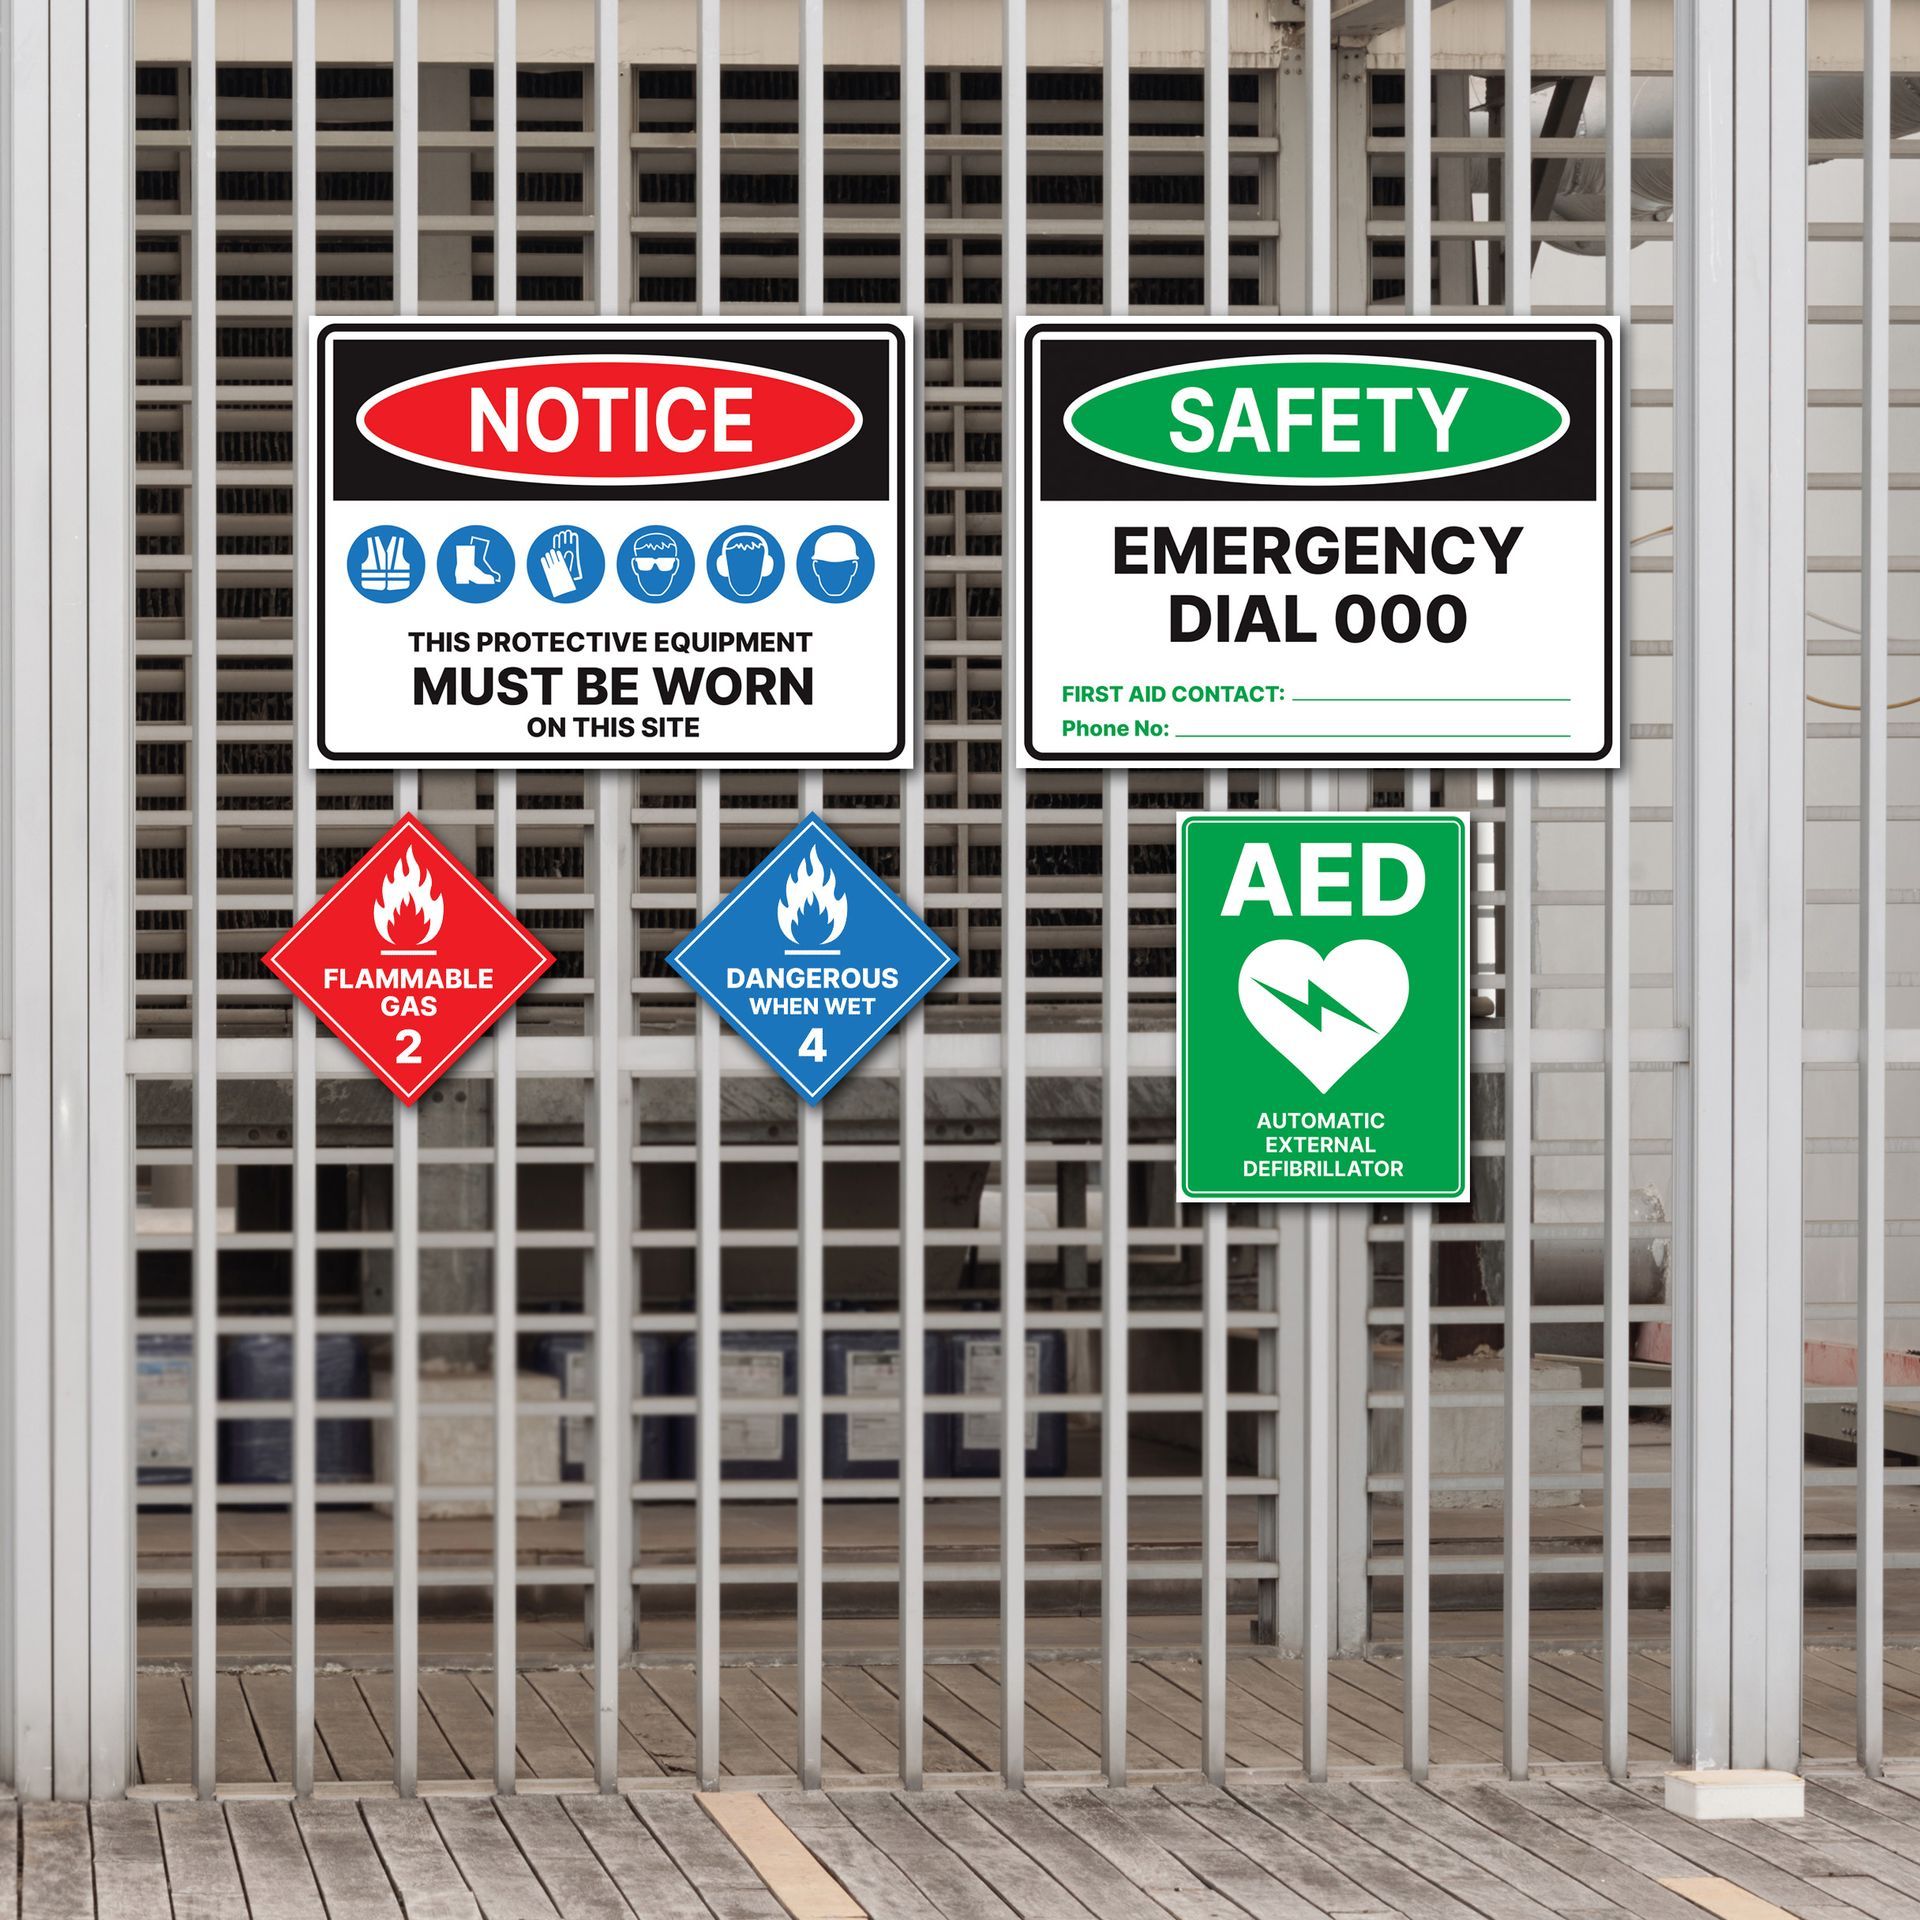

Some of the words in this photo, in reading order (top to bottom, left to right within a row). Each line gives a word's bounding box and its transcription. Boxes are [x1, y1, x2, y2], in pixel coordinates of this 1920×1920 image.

[471, 387, 752, 453] NOTICE
[1170, 387, 1468, 453] SAFETY
[1115, 526, 1524, 574] EMERGENCY
[1171, 595, 1317, 642] DIAL
[1335, 594, 1466, 643] 000
[408, 632, 470, 652] THIS
[478, 632, 647, 652] PROTECTIVE
[655, 632, 813, 653] EQUIPMENT
[414, 667, 563, 705] MUST
[578, 667, 638, 705] BE
[653, 667, 812, 705] WORN
[1063, 686, 1123, 702] FIRST
[1129, 686, 1166, 702] AID
[1172, 686, 1284, 702] CONTACT:
[527, 717, 565, 737] ON
[573, 717, 634, 737] THIS
[642, 717, 699, 737] SITE
[1063, 720, 1129, 736] Phone
[1135, 720, 1168, 736] No:
[1221, 843, 1425, 916] AED
[325, 968, 493, 988] FLAMMABLE
[727, 968, 898, 988] DANGEROUS
[381, 996, 437, 1016] GAS
[749, 998, 818, 1014] WHEN
[824, 998, 876, 1014] WET
[396, 1029, 422, 1063] 2
[799, 1028, 827, 1062] 4
[1257, 1113, 1384, 1129] AUTOMATIC
[1266, 1137, 1376, 1152] EXTERNAL
[1244, 1161, 1403, 1176] DEFIBRILLATOR
